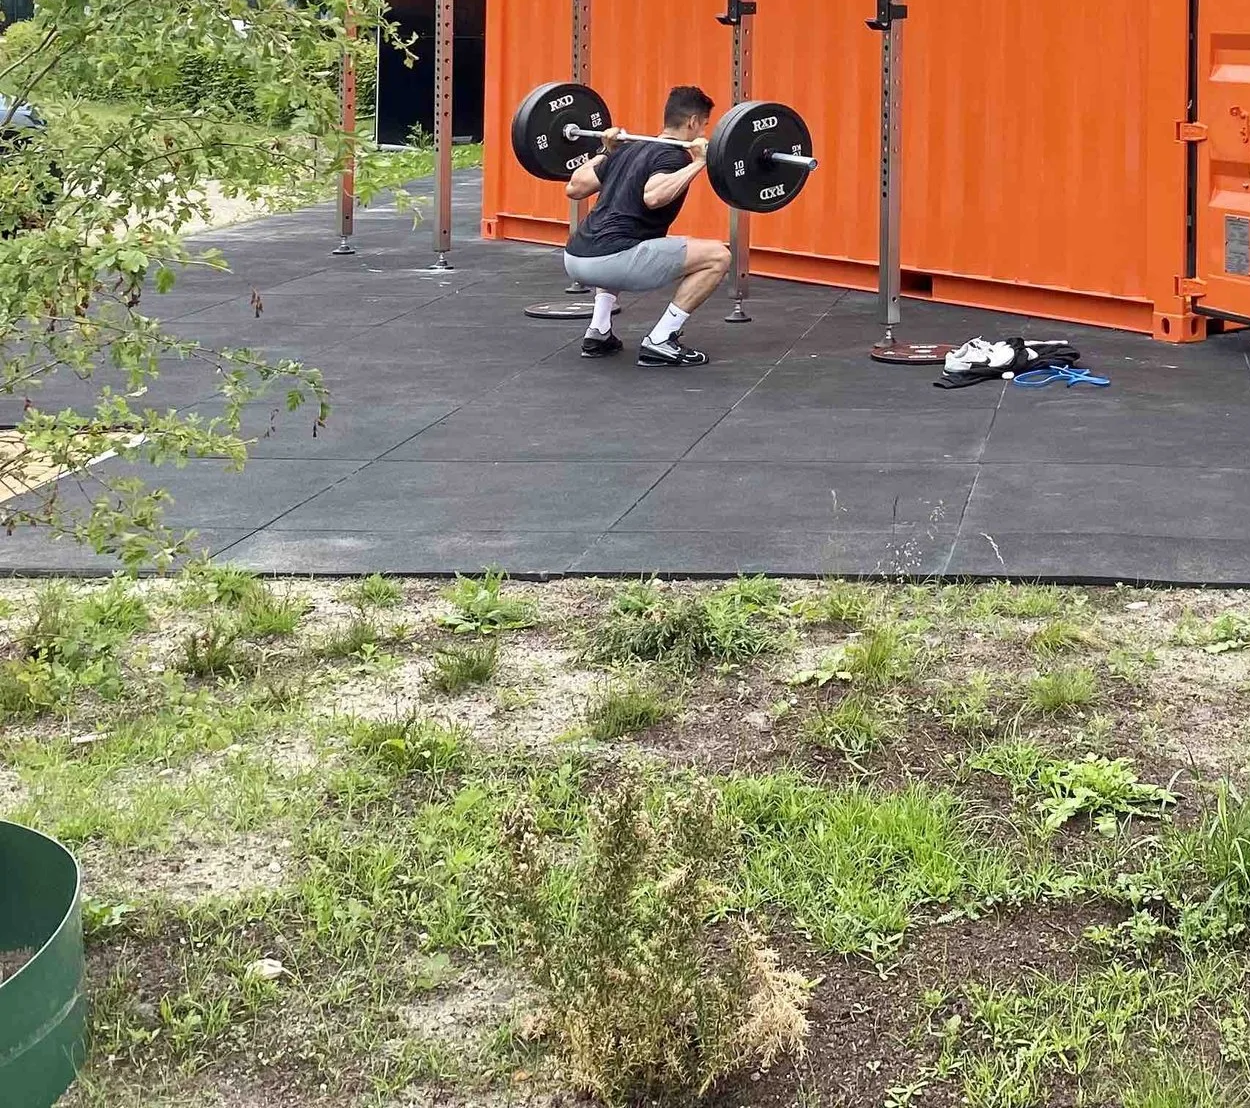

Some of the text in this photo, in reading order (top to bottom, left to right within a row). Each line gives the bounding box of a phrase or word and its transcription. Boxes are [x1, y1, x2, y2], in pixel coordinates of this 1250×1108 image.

[548, 94, 574, 112] RXD
[590, 112, 600, 121] KG
[591, 118, 602, 128] 20
[752, 116, 778, 132] RXD
[536, 134, 547, 144] 20
[538, 141, 548, 150] KG
[733, 160, 744, 170] 10
[735, 168, 745, 177] KG
[760, 184, 785, 200] RXD
